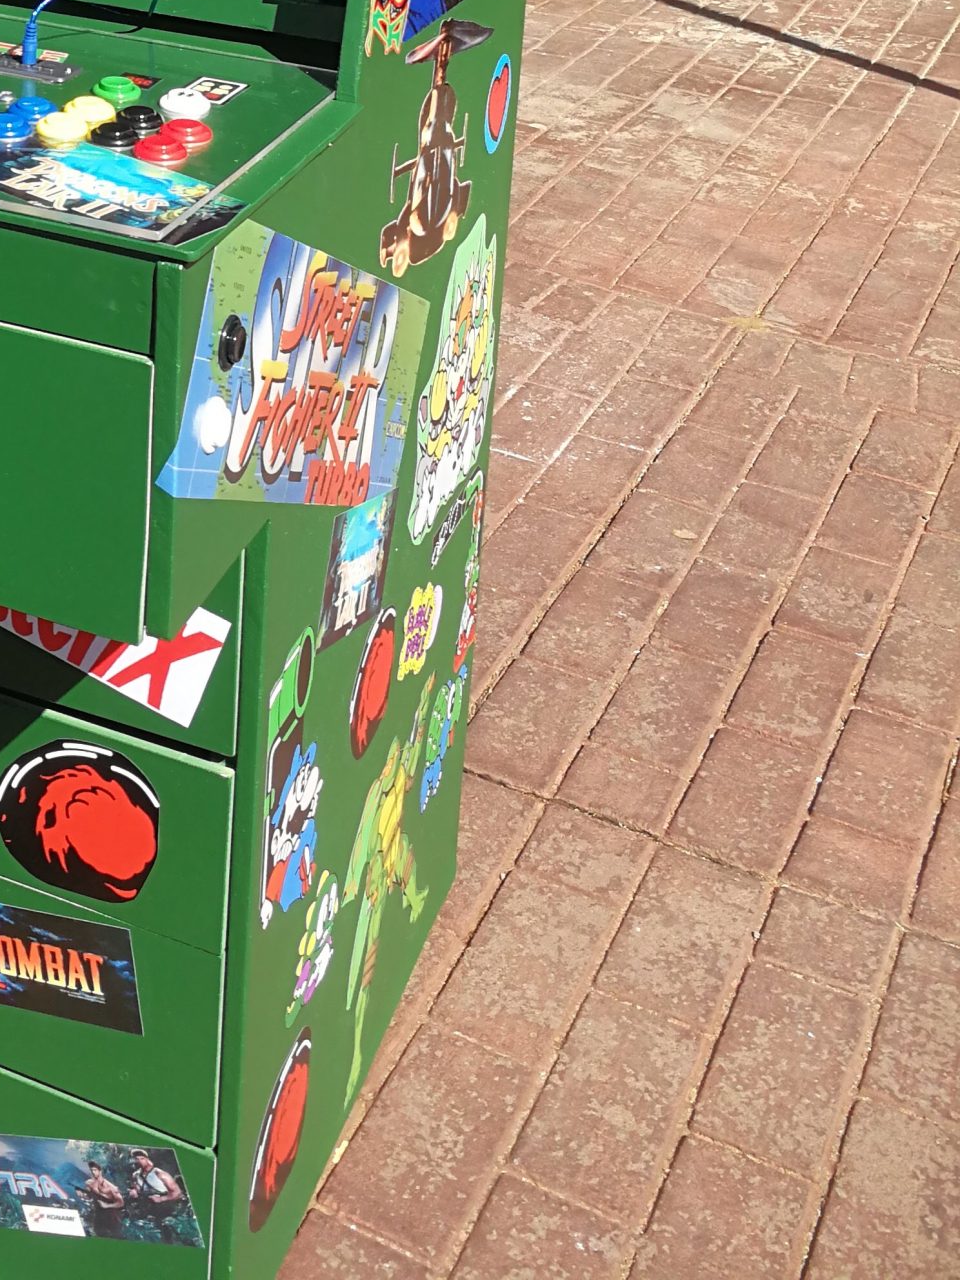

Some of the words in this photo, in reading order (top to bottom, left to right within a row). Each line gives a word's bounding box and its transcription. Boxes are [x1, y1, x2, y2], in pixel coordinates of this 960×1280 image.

[280, 251, 377, 362] STREET
[239, 359, 344, 468] FIGHTER
[303, 460, 370, 506] TURBO
[46, 1213, 75, 1223] KONAMI
